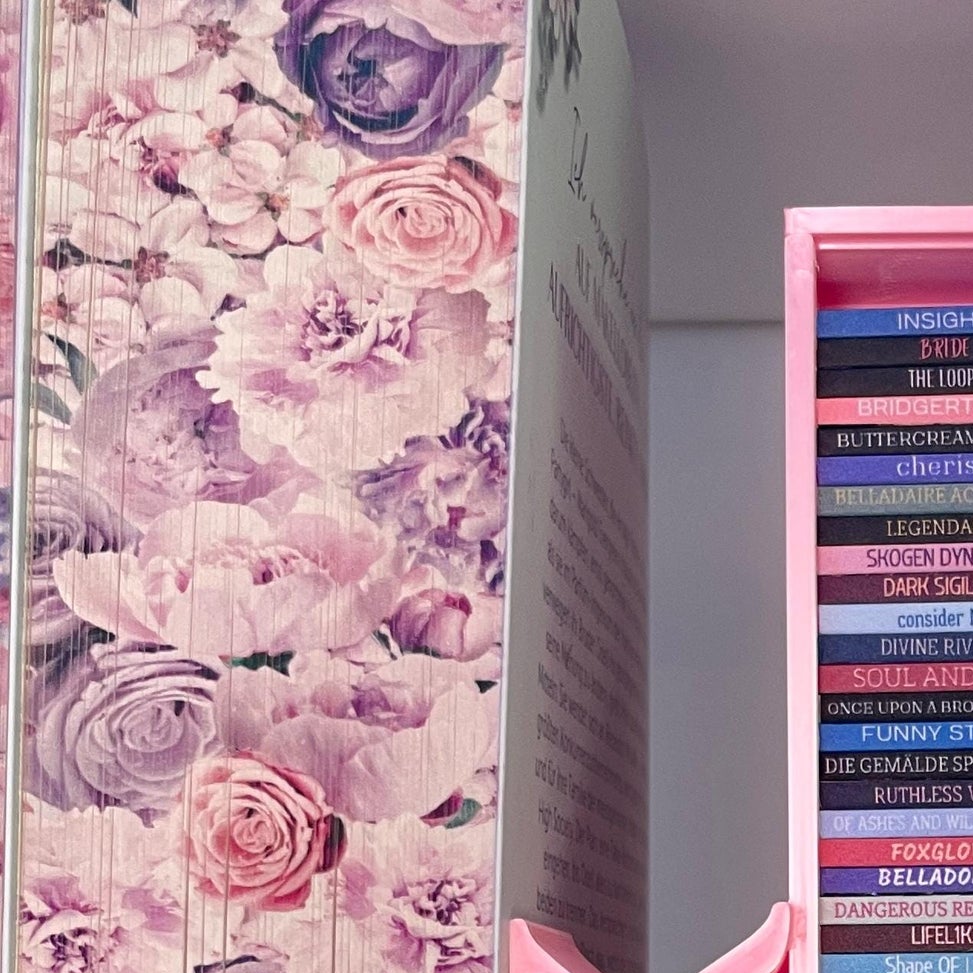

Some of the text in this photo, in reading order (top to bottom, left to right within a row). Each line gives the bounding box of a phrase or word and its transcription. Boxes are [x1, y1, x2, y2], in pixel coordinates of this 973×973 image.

[920, 337, 969, 359] BRIDE
[909, 369, 933, 388] THE
[867, 548, 934, 567] SKOGEN
[884, 576, 929, 596] DARK
[898, 609, 963, 627] consider
[882, 638, 938, 655] DIVINE
[853, 668, 916, 687] SOUL
[828, 701, 873, 715] ONCE
[878, 700, 923, 714] UPON
[927, 700, 937, 713] A
[862, 725, 942, 742] FUNNY
[825, 758, 855, 774] DIE
[860, 754, 949, 773] GEMÄLDE
[875, 786, 963, 804] RUTHLESS
[834, 902, 947, 918] DANGEROUS
[938, 957, 961, 973] OF
